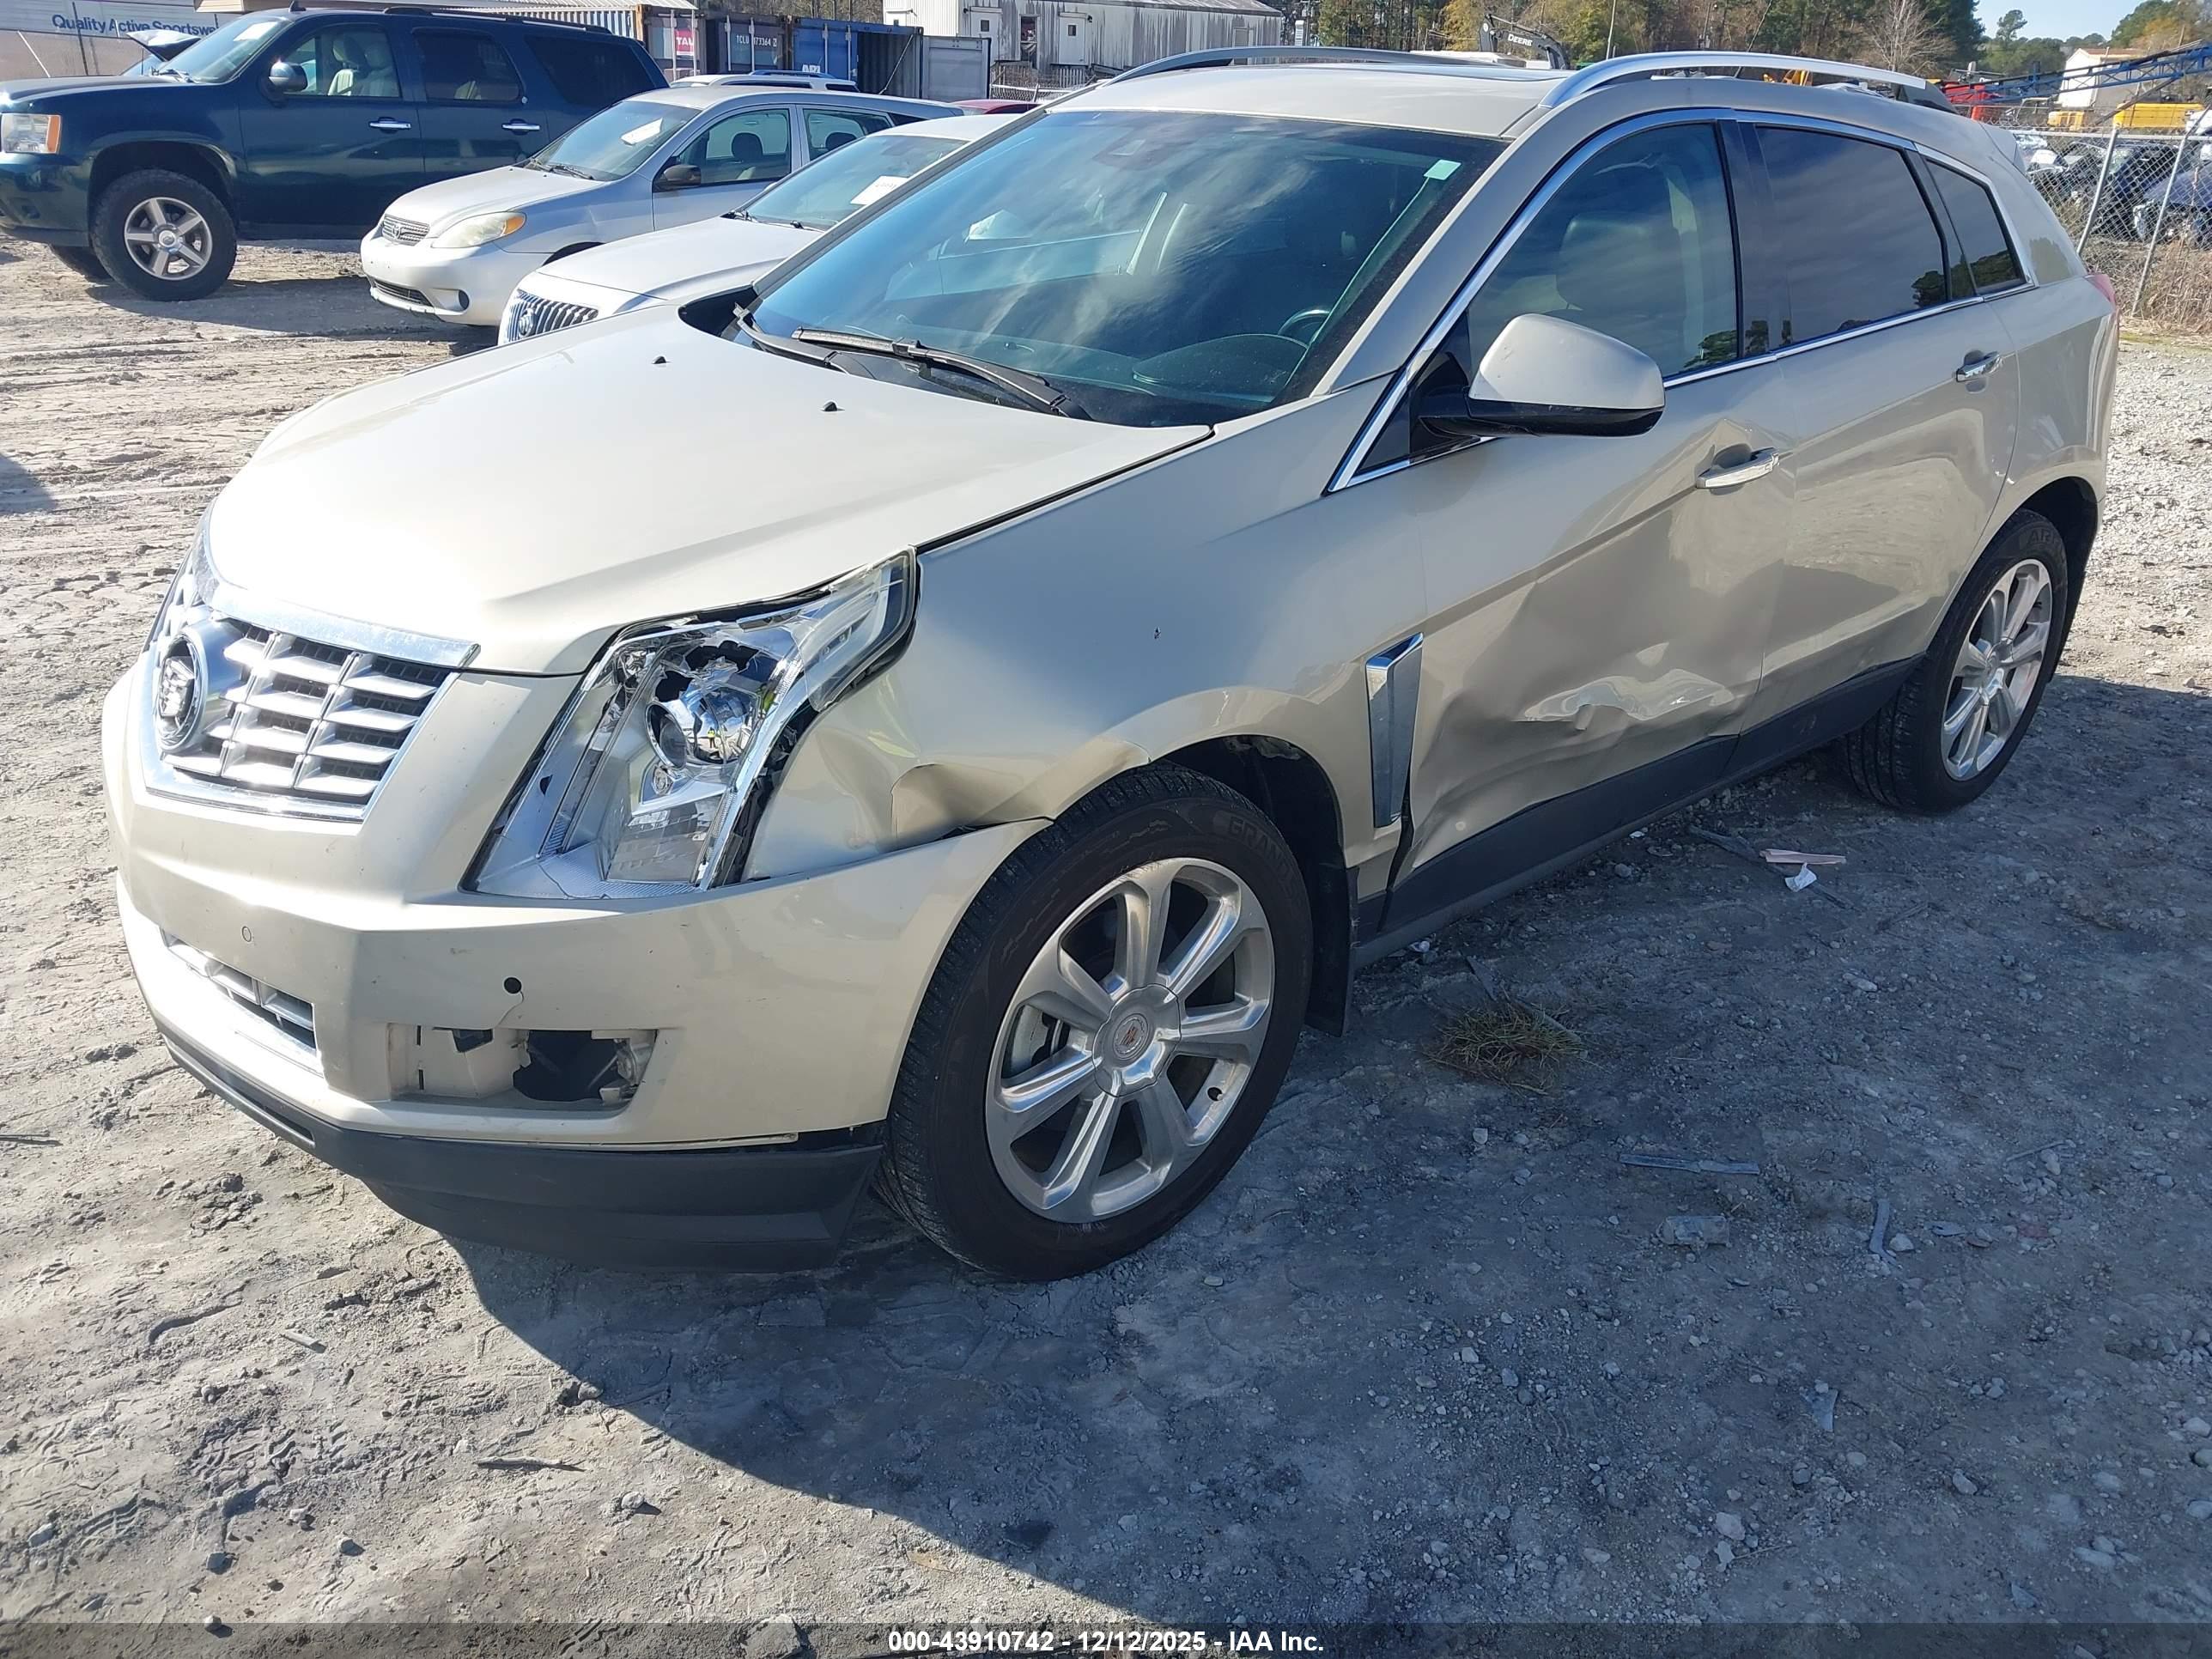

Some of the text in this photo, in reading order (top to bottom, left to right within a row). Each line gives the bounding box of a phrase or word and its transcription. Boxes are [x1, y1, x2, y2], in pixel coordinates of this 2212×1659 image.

[52, 14, 106, 33] Quality
[109, 18, 150, 33] Active
[736, 34, 750, 44] TCLU
[1508, 33, 1533, 46] DEERE
